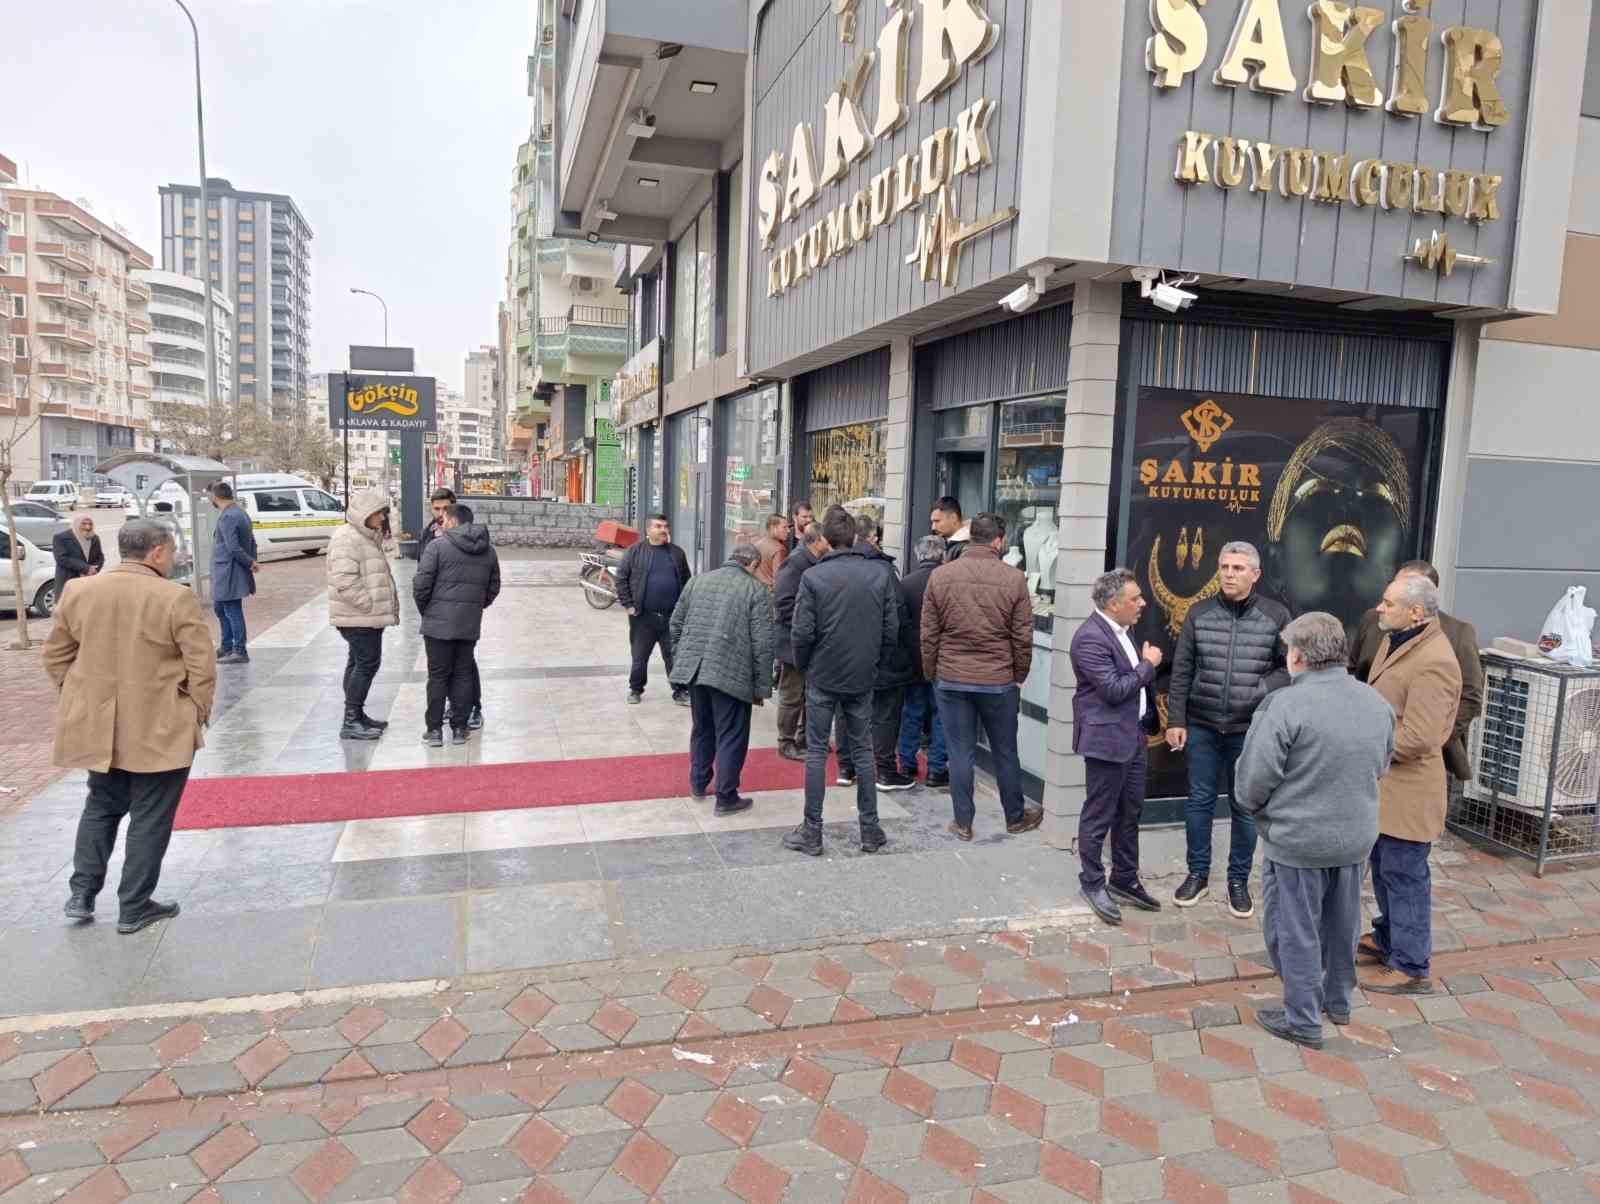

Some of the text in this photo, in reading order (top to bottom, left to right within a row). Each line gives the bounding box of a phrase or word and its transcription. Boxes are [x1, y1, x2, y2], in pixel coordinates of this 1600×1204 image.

[1144, 0, 1508, 131] ŞAKİR
[1175, 131, 1503, 223] KUYUMCULUK
[766, 97, 996, 297] KUYUMCULUK
[347, 383, 418, 412] Gökçin
[381, 419, 388, 427] &
[389, 419, 428, 429] KADAYIF
[1140, 457, 1262, 487] ŞAKİR
[1148, 486, 1261, 502] KUYUMCULUK
